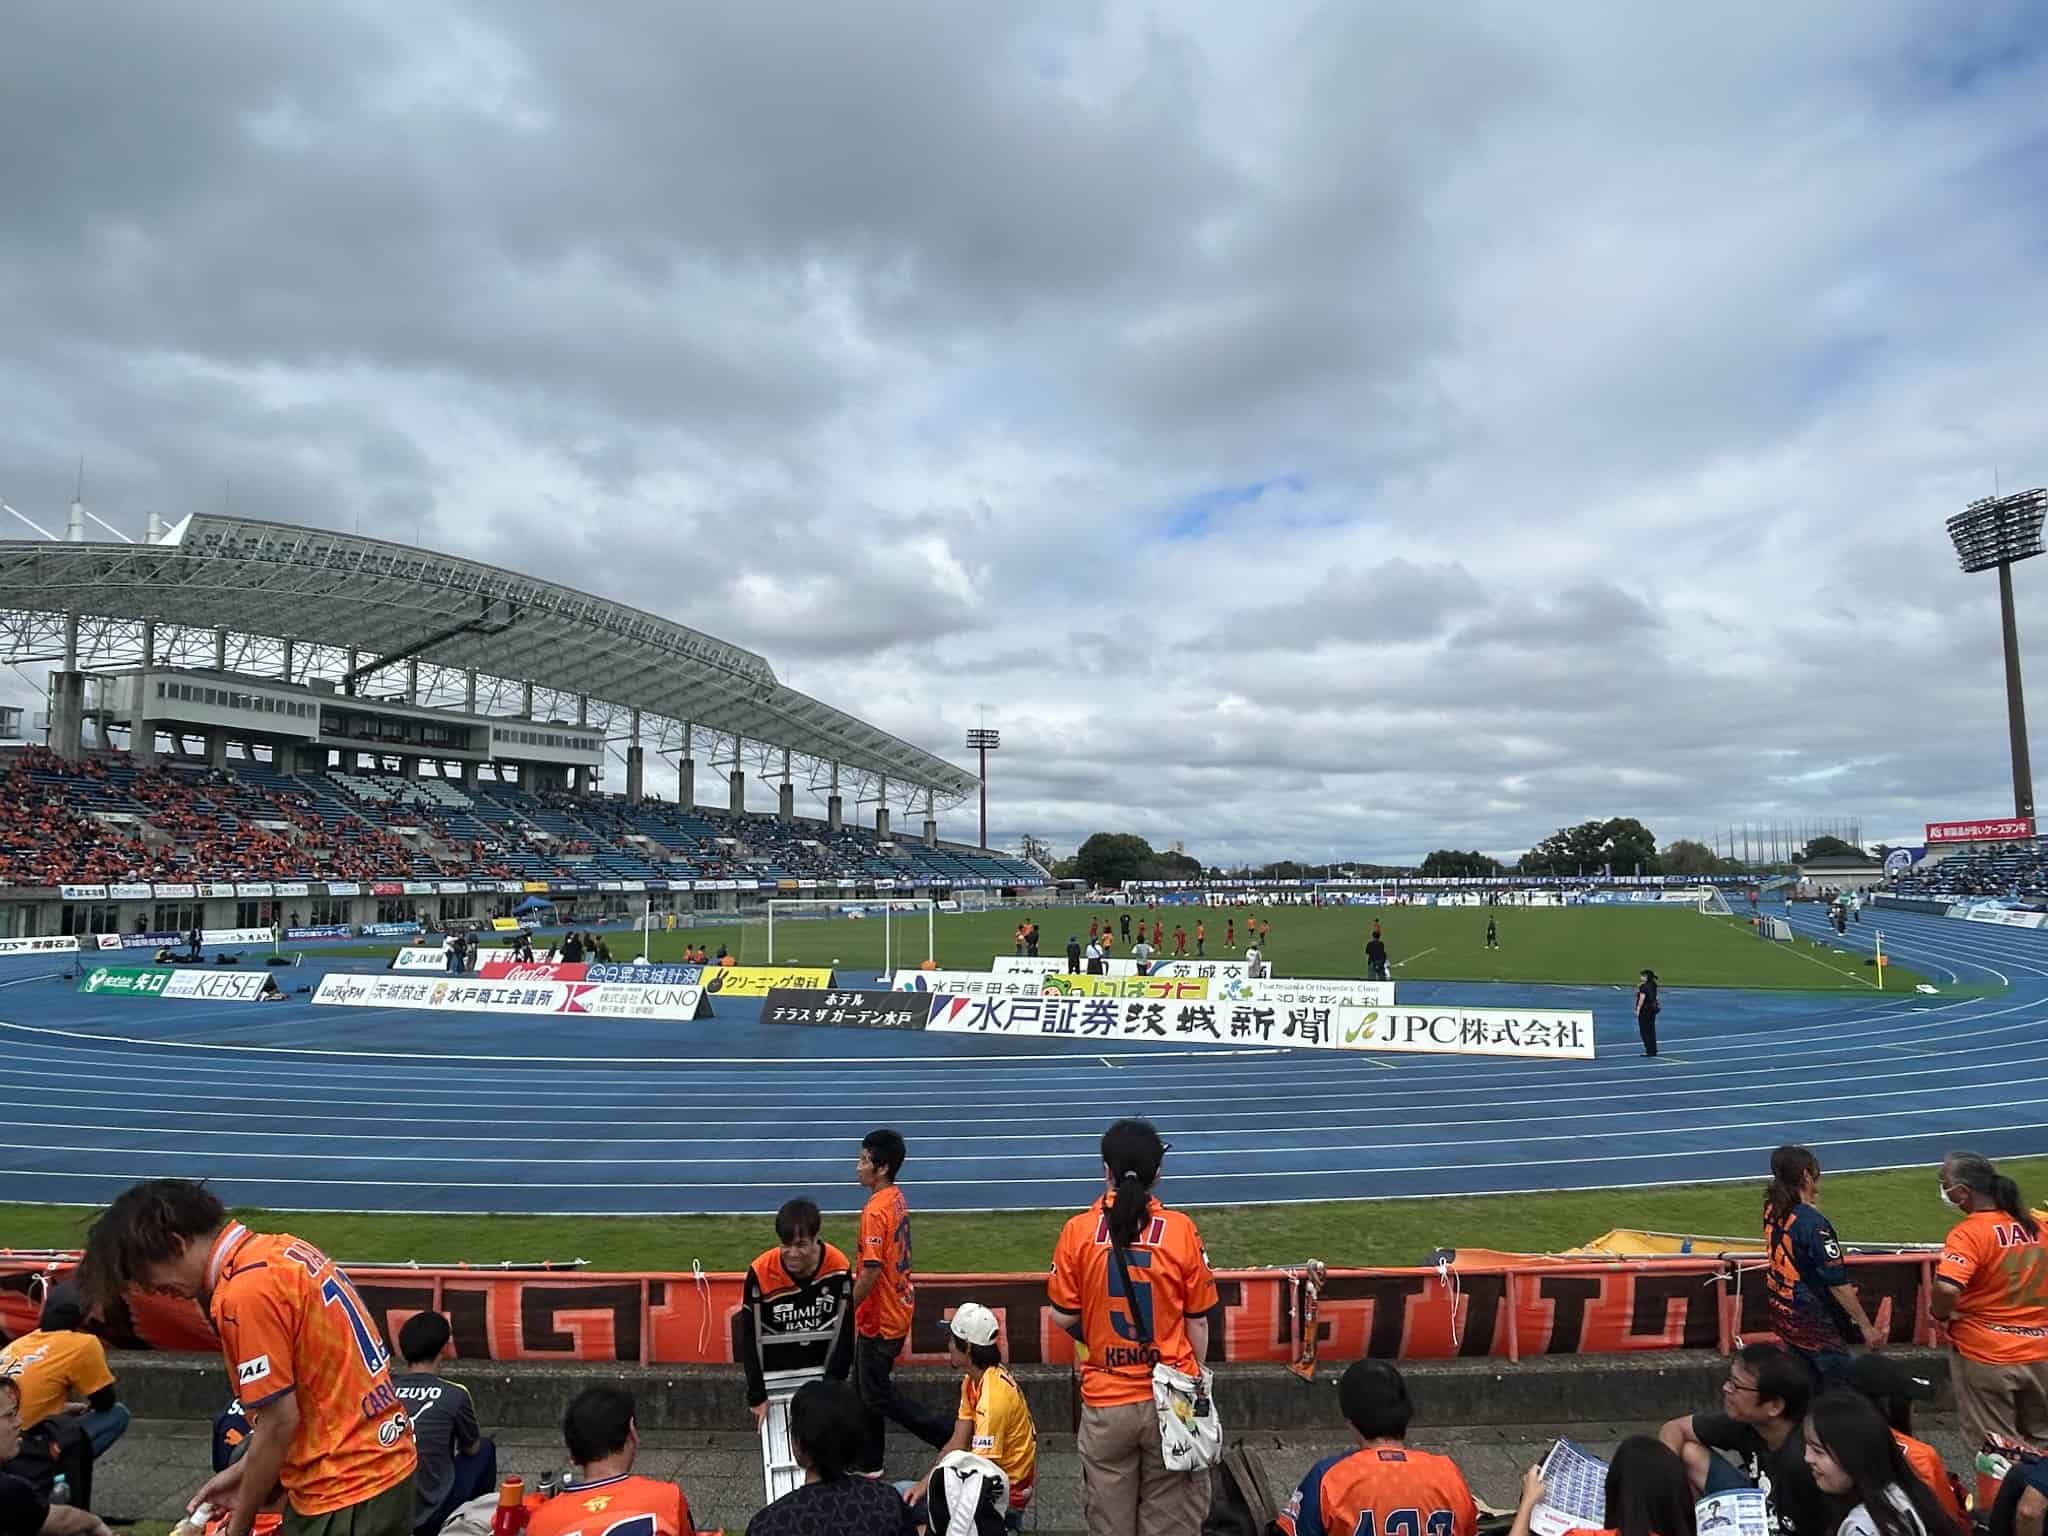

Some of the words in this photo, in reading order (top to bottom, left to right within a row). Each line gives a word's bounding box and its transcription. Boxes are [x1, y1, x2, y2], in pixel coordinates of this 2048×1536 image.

[132, 973, 167, 991] 矢口
[446, 988, 553, 1006] 水戸商工会議所
[640, 988, 699, 1007] KUNO
[824, 993, 864, 1007] ホテル
[772, 1008, 810, 1021] テラス
[814, 1009, 827, 1021] ザ
[829, 1009, 913, 1026] ガーデン水戸
[967, 995, 1119, 1034] 水戸証券
[1123, 1002, 1331, 1045] 茨城新聞
[1107, 1247, 1153, 1343] 5
